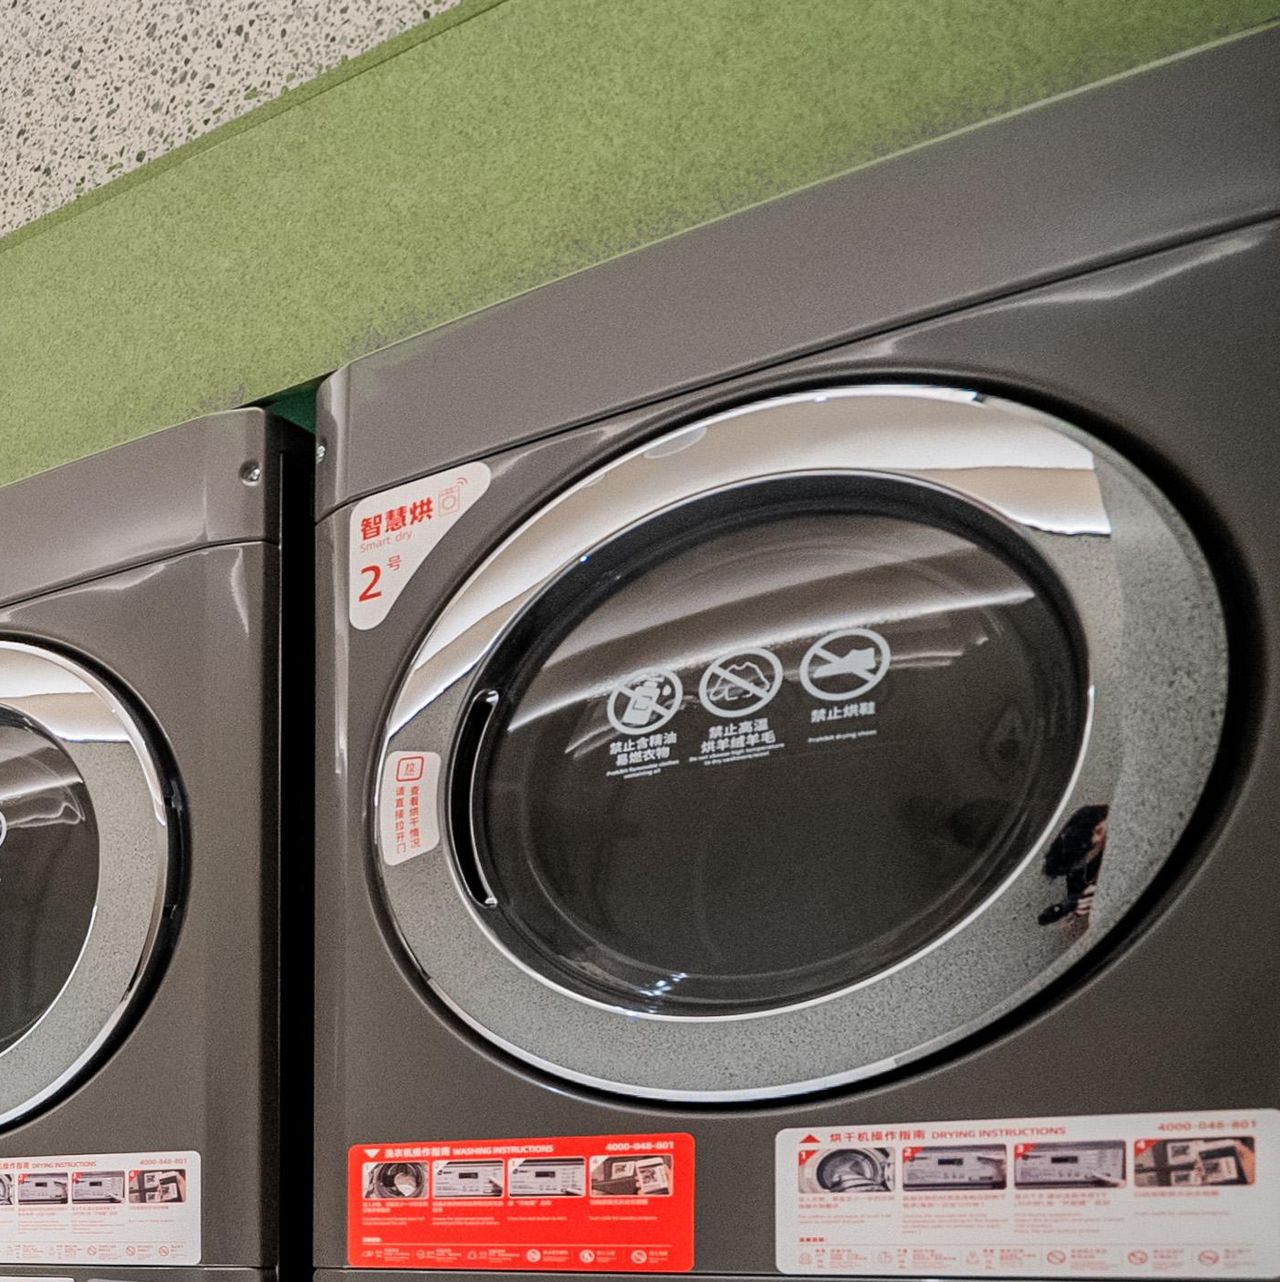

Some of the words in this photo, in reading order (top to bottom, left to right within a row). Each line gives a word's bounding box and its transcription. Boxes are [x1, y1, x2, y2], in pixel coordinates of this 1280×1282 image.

[360, 497, 434, 541] 智慧烘
[360, 538, 391, 553] Smart
[395, 530, 414, 544] dry
[830, 1130, 926, 1143] 烘干机操作指南
[931, 1129, 977, 1140] DRYING
[979, 1126, 1066, 1138] INSTRUCTIONS
